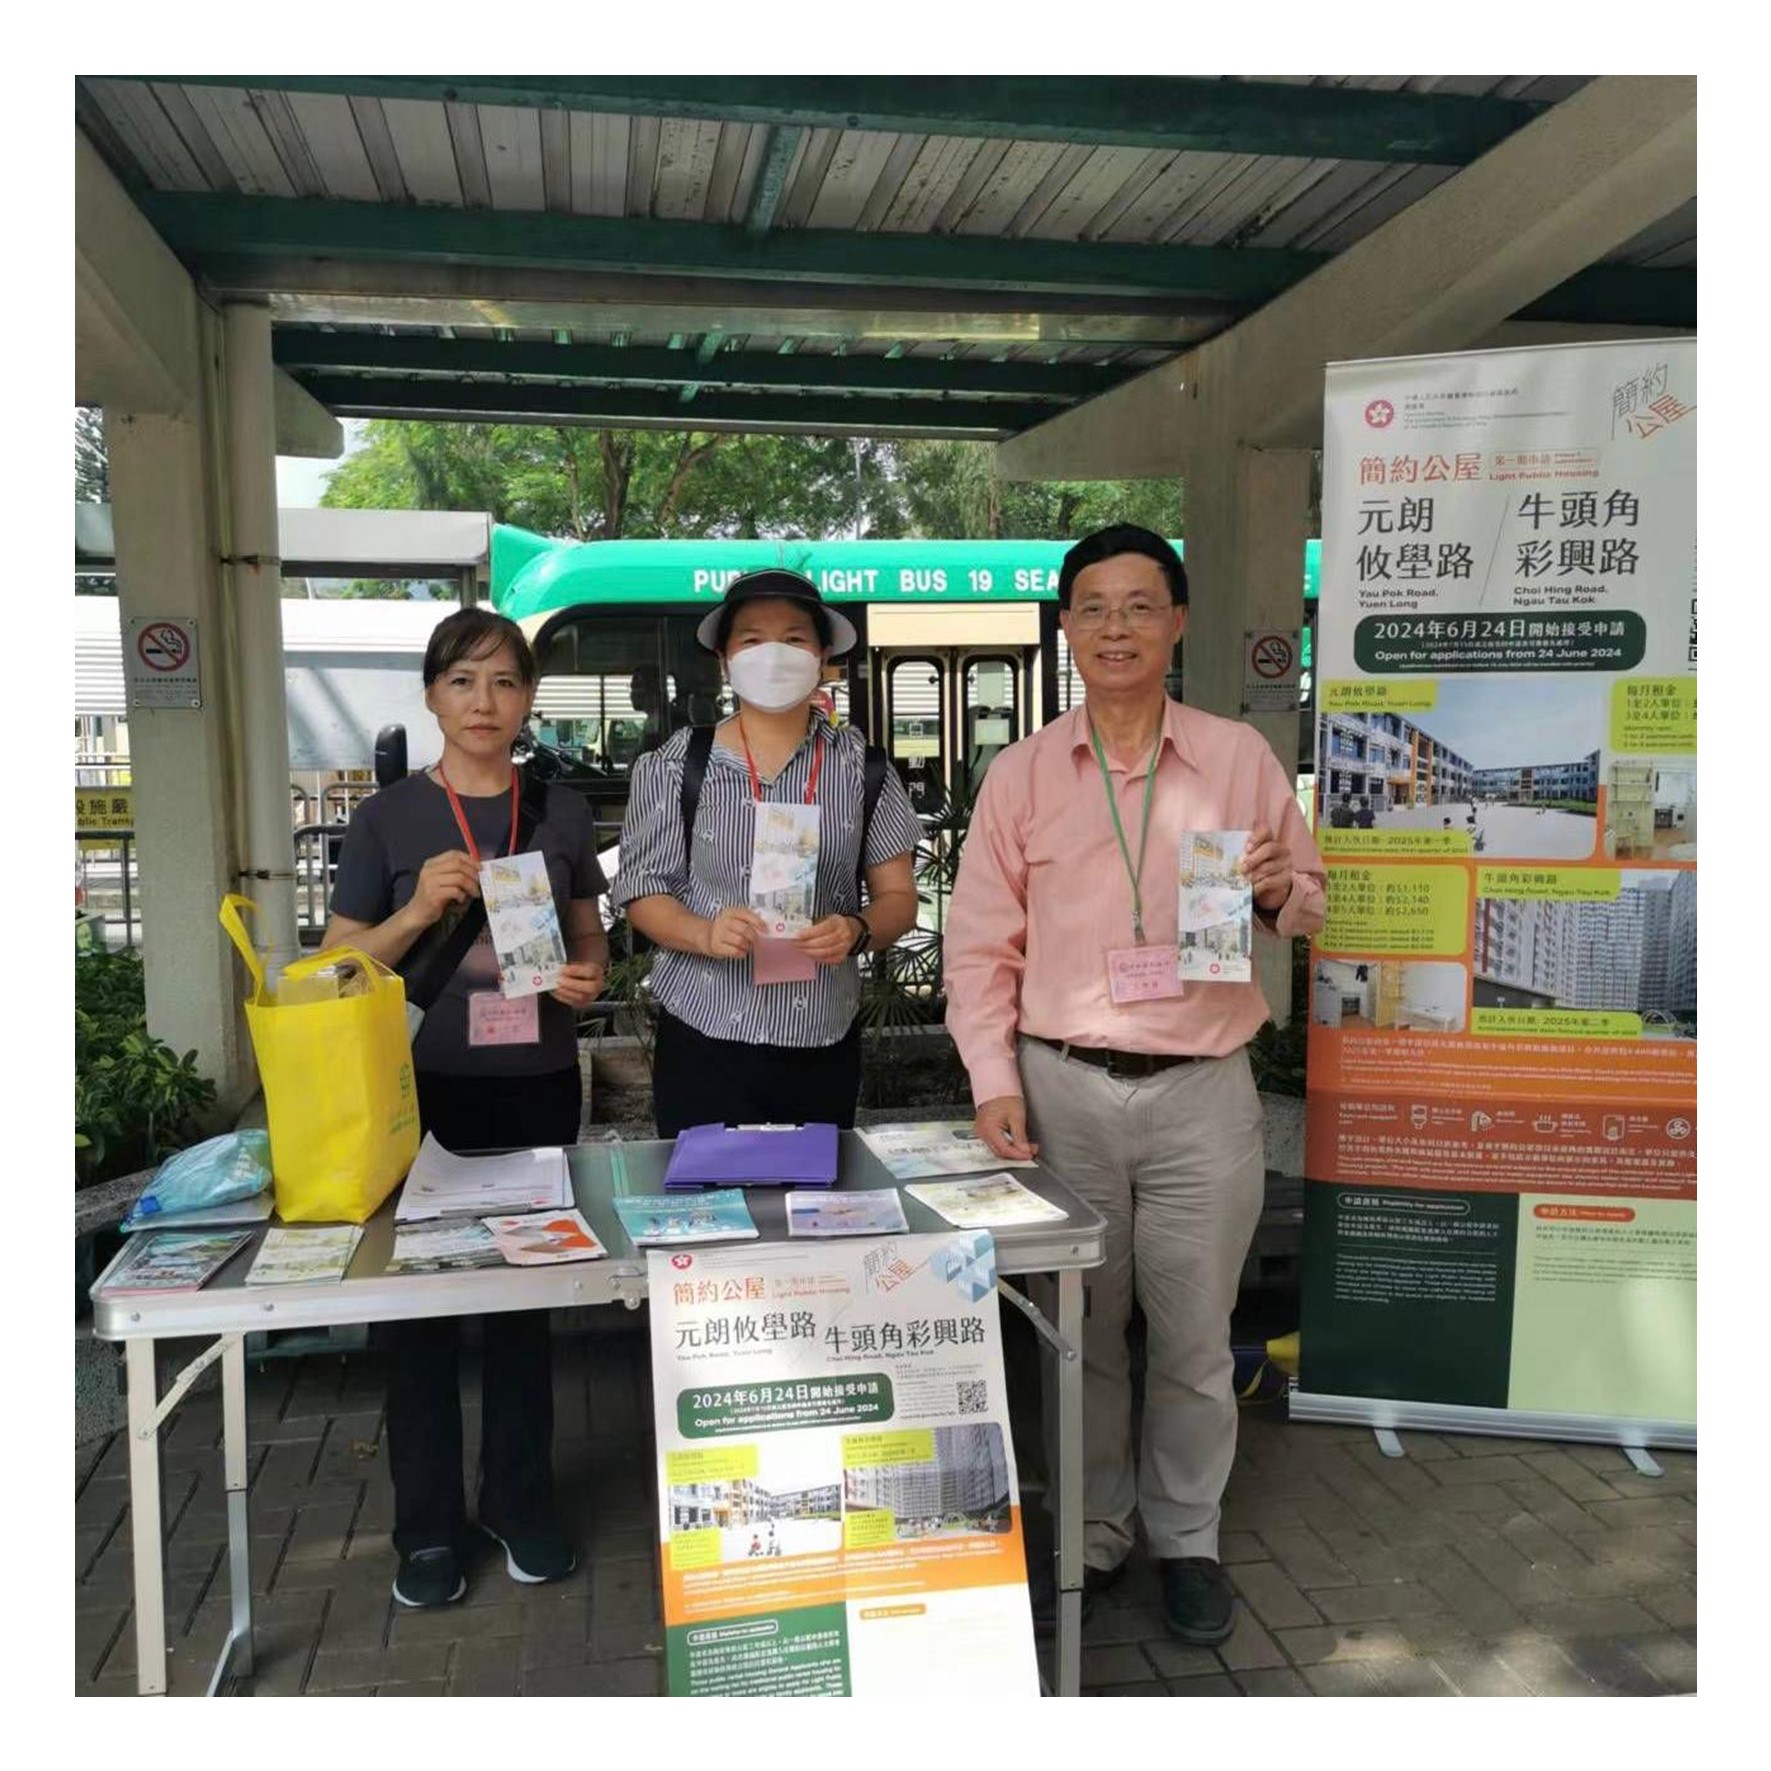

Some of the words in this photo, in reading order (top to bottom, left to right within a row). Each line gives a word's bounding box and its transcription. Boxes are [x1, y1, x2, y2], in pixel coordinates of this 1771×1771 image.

[1360, 453, 1482, 485] 簡約公屋
[1489, 472, 1516, 482] Light
[1357, 497, 1434, 535] 元朗
[1518, 489, 1639, 530] 牛頭角
[1356, 542, 1474, 581] 攸壆路
[1515, 538, 1640, 578] 彩興路
[900, 569, 948, 592] BUS
[968, 570, 993, 592] 19
[1014, 569, 1059, 592] SEA
[1382, 589, 1404, 598] Pok
[1514, 587, 1541, 595] Choi
[1544, 586, 1572, 596] Hing
[1389, 600, 1418, 610] Long
[1513, 598, 1545, 607] Ngau
[1549, 597, 1569, 605] Tau
[1572, 596, 1596, 604] Kok
[1374, 619, 1626, 639] 2024年6月24日開始接受申請
[1375, 651, 1407, 661] Open
[1410, 651, 1427, 659] for
[1430, 650, 1503, 661] applications
[1506, 649, 1536, 658] from
[1538, 649, 1553, 657] 24
[1556, 648, 1588, 657] June
[1591, 648, 1622, 657] 2024
[673, 1277, 766, 1306] 簡約公屋
[675, 1311, 816, 1349] 元朗攸壆路
[825, 1316, 985, 1354] 牛頭角彩興路
[693, 1381, 879, 1408] 2024年6月24日開始接受申請
[695, 1417, 720, 1429] Open
[722, 1416, 736, 1425] for
[738, 1411, 794, 1425] applications
[796, 1408, 819, 1418] from
[820, 1407, 832, 1416] 24
[833, 1405, 856, 1414] June
[857, 1403, 879, 1413] 2024
